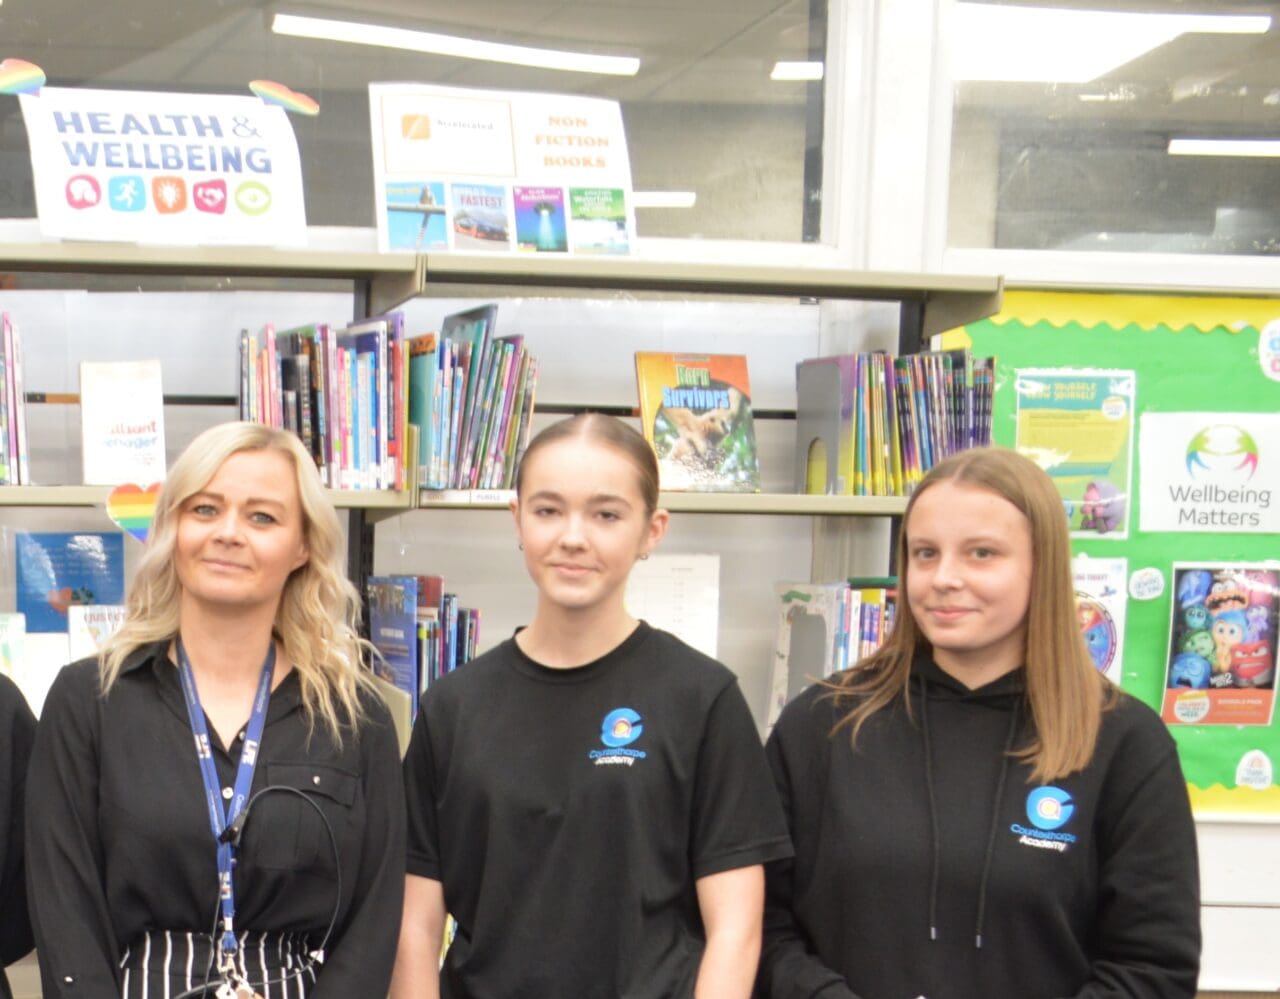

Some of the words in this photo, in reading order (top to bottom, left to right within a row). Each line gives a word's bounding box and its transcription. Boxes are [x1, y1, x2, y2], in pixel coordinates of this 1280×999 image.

[52, 111, 224, 138] HEALTH
[232, 112, 263, 138] &
[547, 115, 588, 128] NON
[534, 135, 610, 148] FICTION
[62, 141, 273, 174] WELLBEING
[543, 155, 607, 169] BOOKS
[459, 194, 503, 208] FASTEST
[662, 386, 730, 409] Survivors
[1169, 485, 1272, 508] Wellbeing
[1178, 508, 1261, 526] Matters
[1019, 834, 1068, 852] Academy
